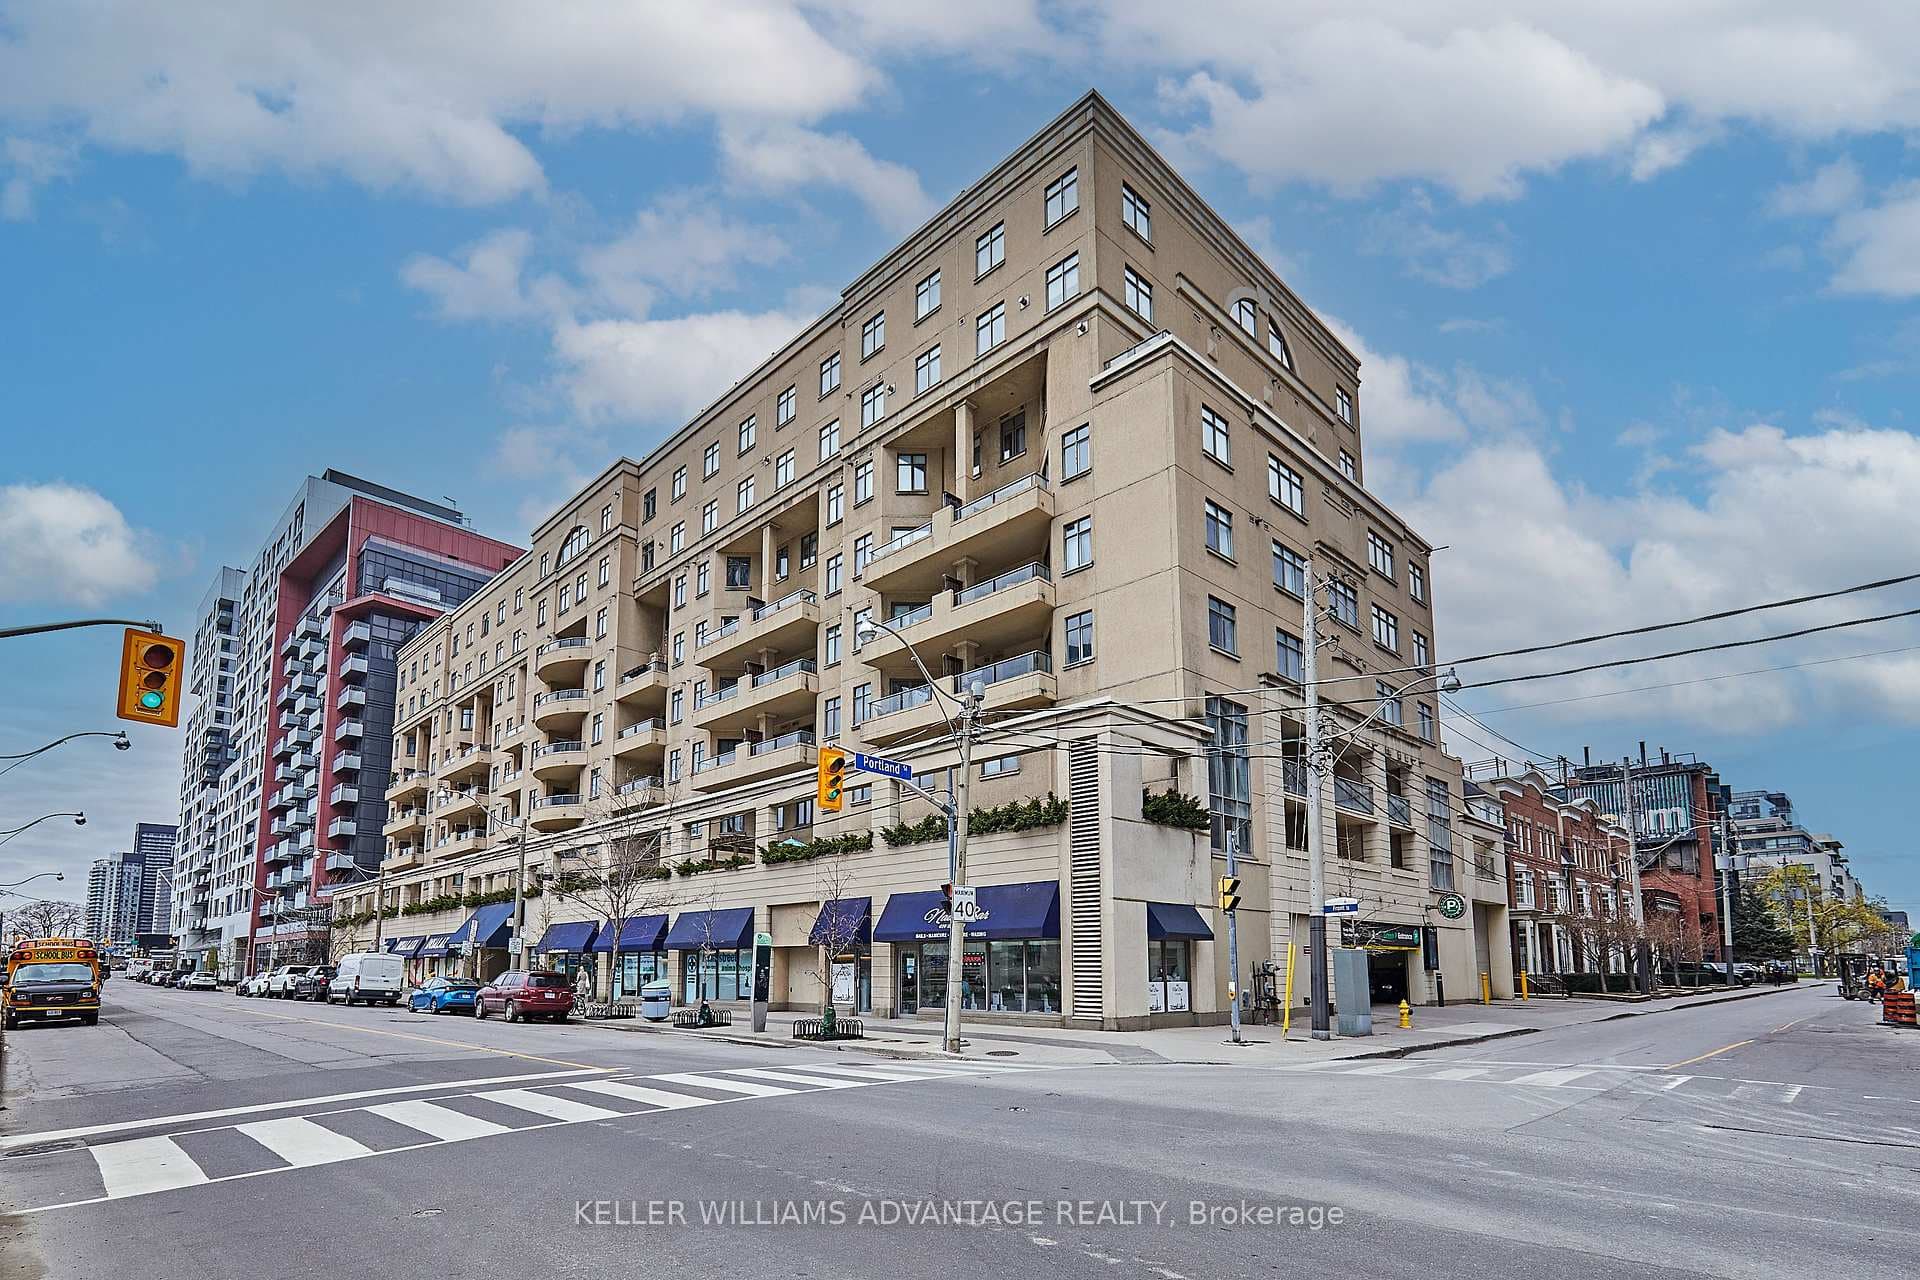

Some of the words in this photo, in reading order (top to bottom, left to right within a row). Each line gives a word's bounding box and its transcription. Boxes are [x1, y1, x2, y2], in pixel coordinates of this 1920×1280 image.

[863, 755, 900, 775] Portland
[955, 901, 975, 917] 40
[35, 951, 60, 960] SCHOOL
[61, 950, 73, 959] BUS
